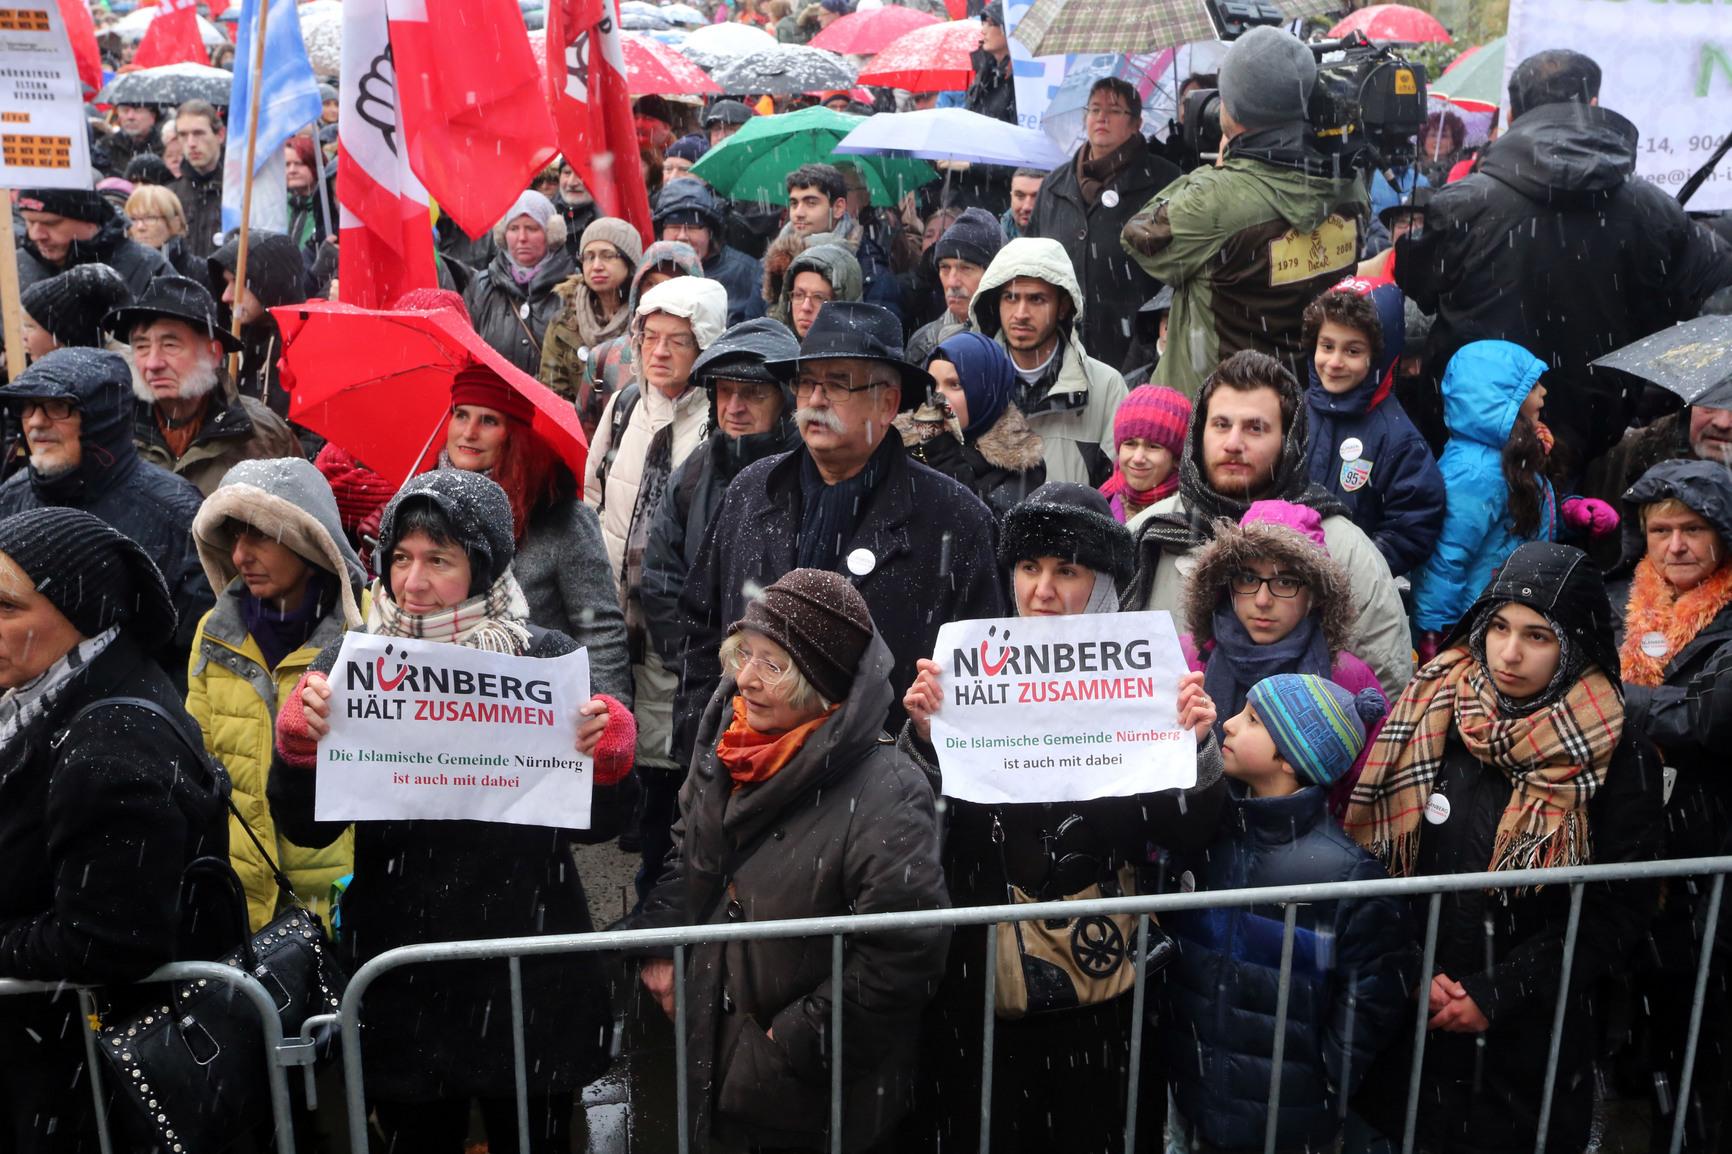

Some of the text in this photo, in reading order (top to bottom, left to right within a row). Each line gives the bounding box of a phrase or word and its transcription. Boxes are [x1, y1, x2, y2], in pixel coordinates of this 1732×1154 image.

[1345, 471, 1359, 486] 95
[953, 625, 1152, 678] NÜRNBERG
[347, 643, 553, 704] NÜRNBERG
[955, 677, 1154, 706] HÄLT ZUSAMMEN
[347, 694, 555, 726] HÄLT ZUSAMMEN
[946, 729, 1181, 749] Die Islamische Gemeinde Nürnberg
[329, 749, 584, 774] Die Islamische Gemeinde Nürnberg
[1003, 753, 1123, 770] ist auch mit dabei
[393, 772, 520, 788] ist auch mit dabei
